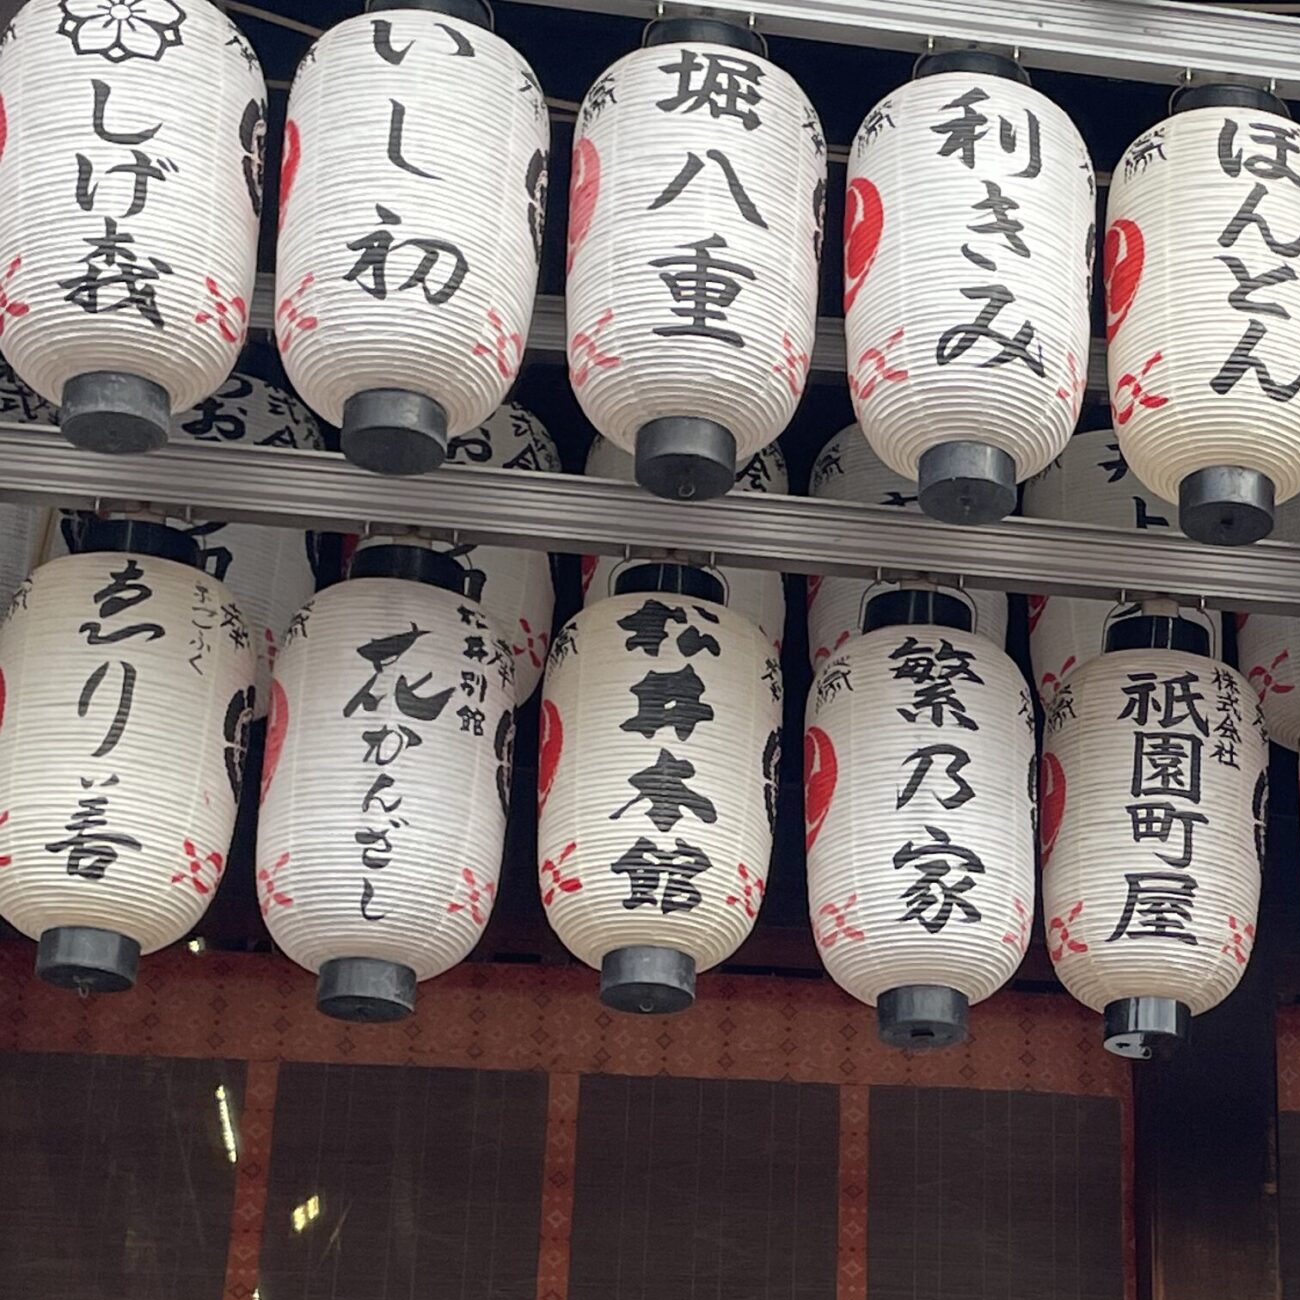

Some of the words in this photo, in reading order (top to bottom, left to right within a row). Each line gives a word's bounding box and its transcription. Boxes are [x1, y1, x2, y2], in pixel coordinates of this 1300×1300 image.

[343, 19, 475, 304] いし初
[649, 49, 768, 348] 堀八重
[931, 86, 1047, 377] 利きみ
[343, 622, 456, 920] 花かんざし
[609, 599, 720, 914] 松井本館
[888, 637, 986, 934] 繁乃家
[1105, 671, 1209, 945] 祇園町屋
[1210, 666, 1242, 771] 株式会社
